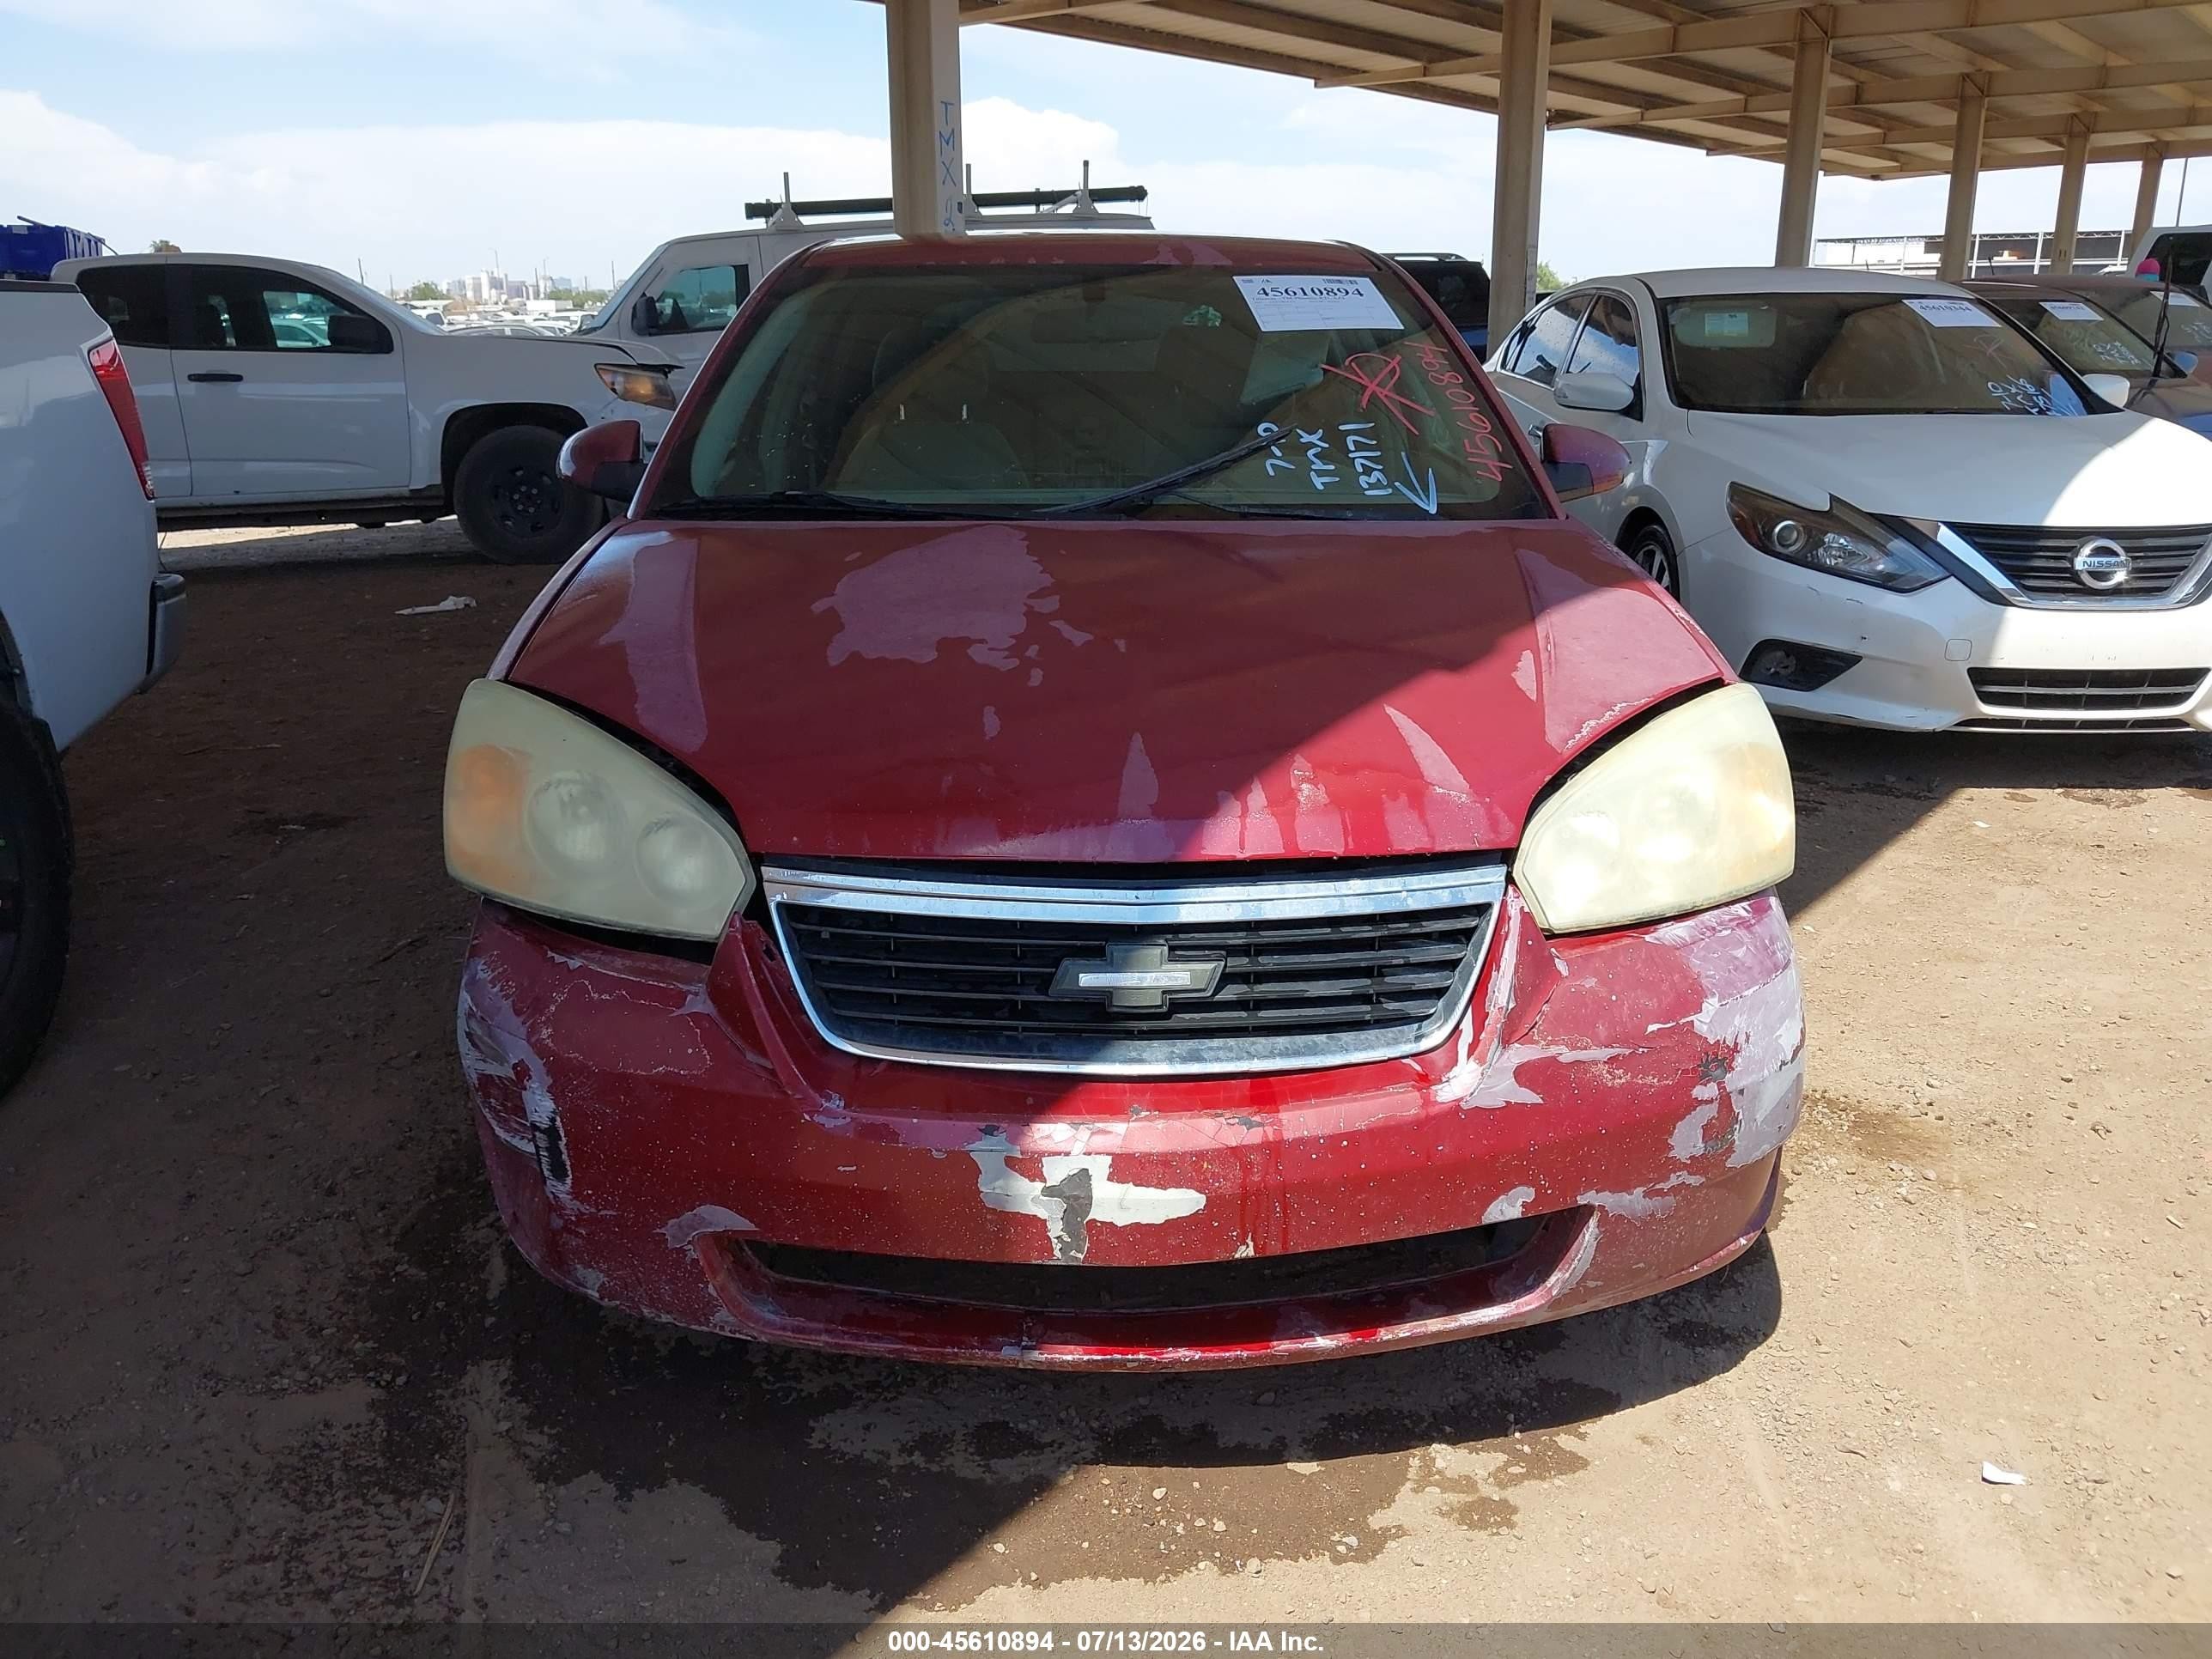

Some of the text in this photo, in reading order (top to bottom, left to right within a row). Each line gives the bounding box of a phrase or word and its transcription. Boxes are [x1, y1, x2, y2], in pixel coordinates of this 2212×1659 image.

[939, 100, 957, 187] TMX
[1256, 287, 1364, 298] 45610894
[1402, 342, 1513, 482] 45610894
[1338, 422, 1393, 495] 137171
